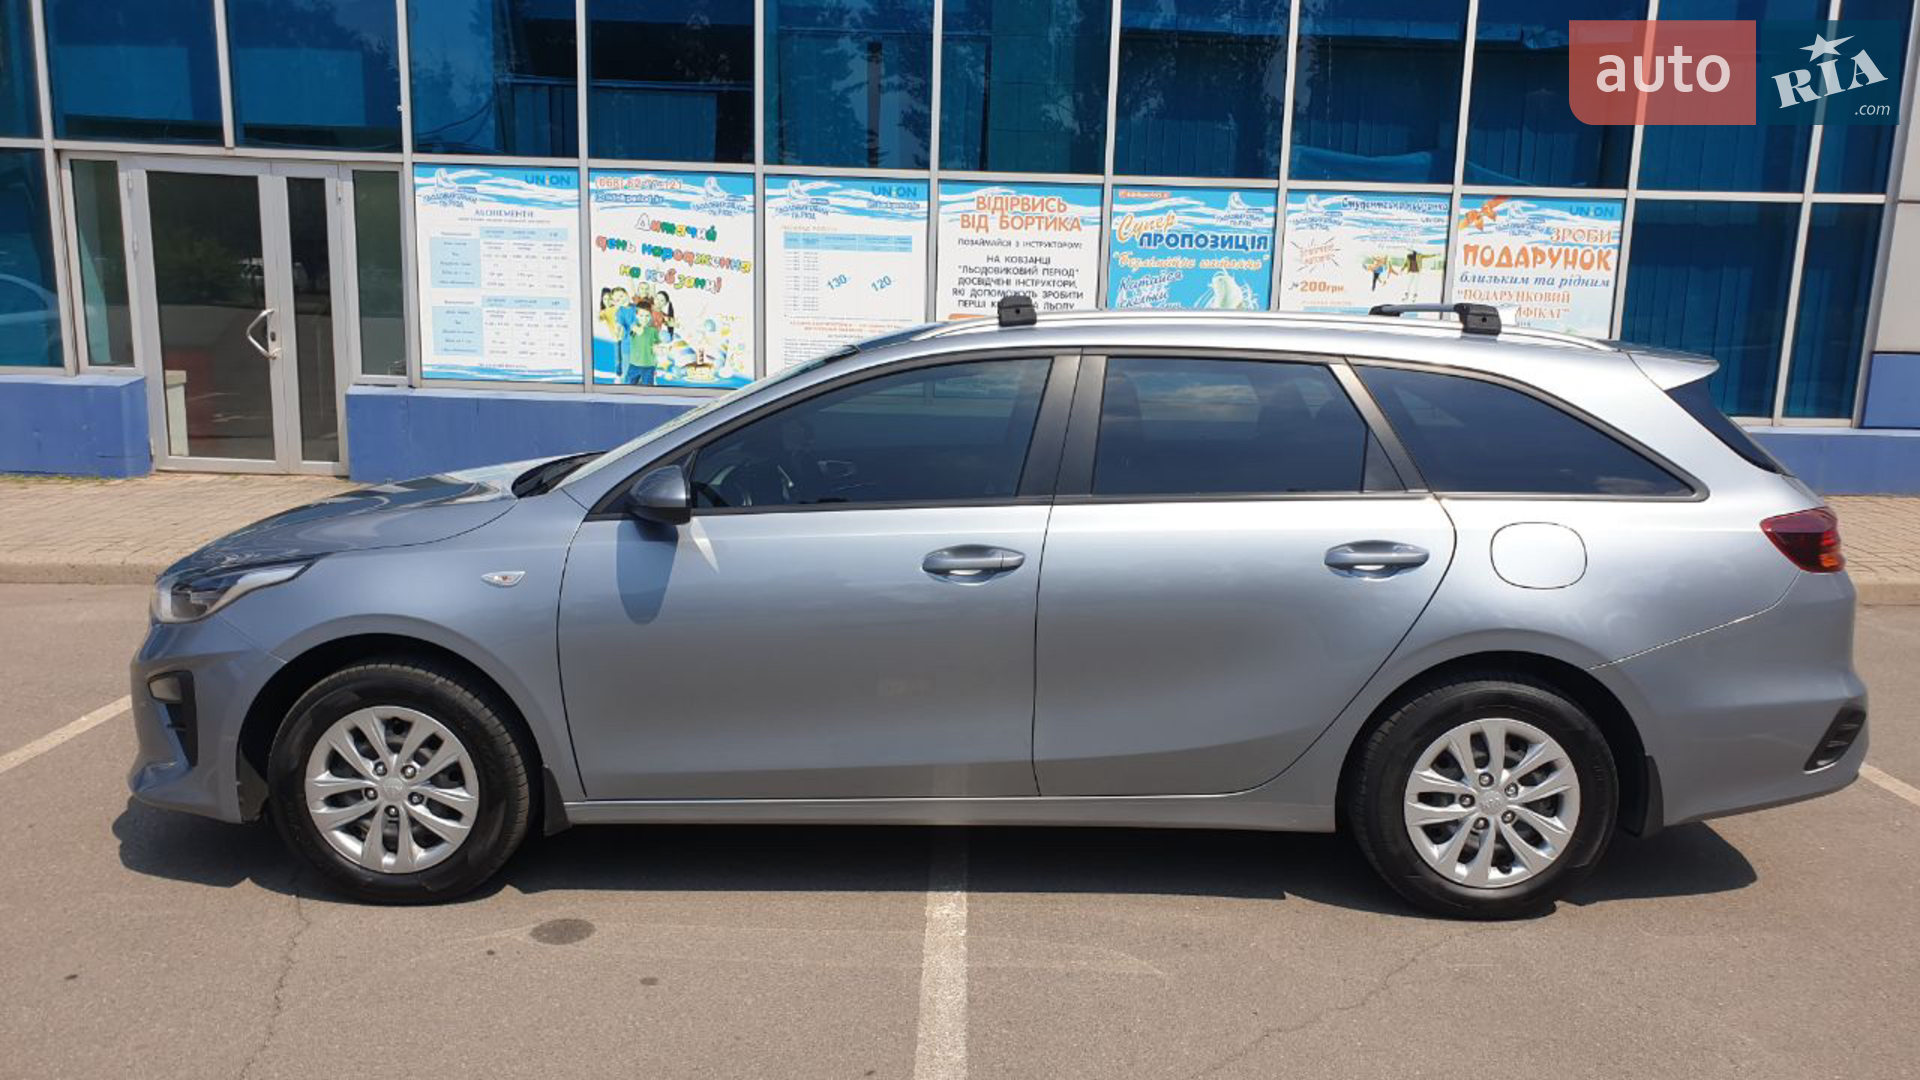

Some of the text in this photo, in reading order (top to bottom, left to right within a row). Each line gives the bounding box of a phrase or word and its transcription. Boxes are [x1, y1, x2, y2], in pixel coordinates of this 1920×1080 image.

[871, 185, 917, 198] UNION
[976, 195, 1068, 214] ВІДІРВИСЬ
[1570, 205, 1615, 217] UNION
[960, 214, 1082, 233] ВІД БОРТИКА
[1139, 232, 1269, 251] ПРОПОЗИЦІЯ
[1551, 228, 1612, 244] ЗРОБИ
[986, 255, 1051, 265] НА КОВЗАНЦІ
[1463, 244, 1612, 271] ПОДАРУНОК
[619, 264, 642, 279] на
[827, 273, 848, 290] 130
[871, 275, 893, 292] 120
[957, 277, 1012, 287] ДОСВІДЧЕНІ
[1460, 271, 1611, 289] близьким та рідним
[1042, 290, 1084, 299] ЗРОБИТИ
[958, 300, 986, 308] ПЕРШІ
